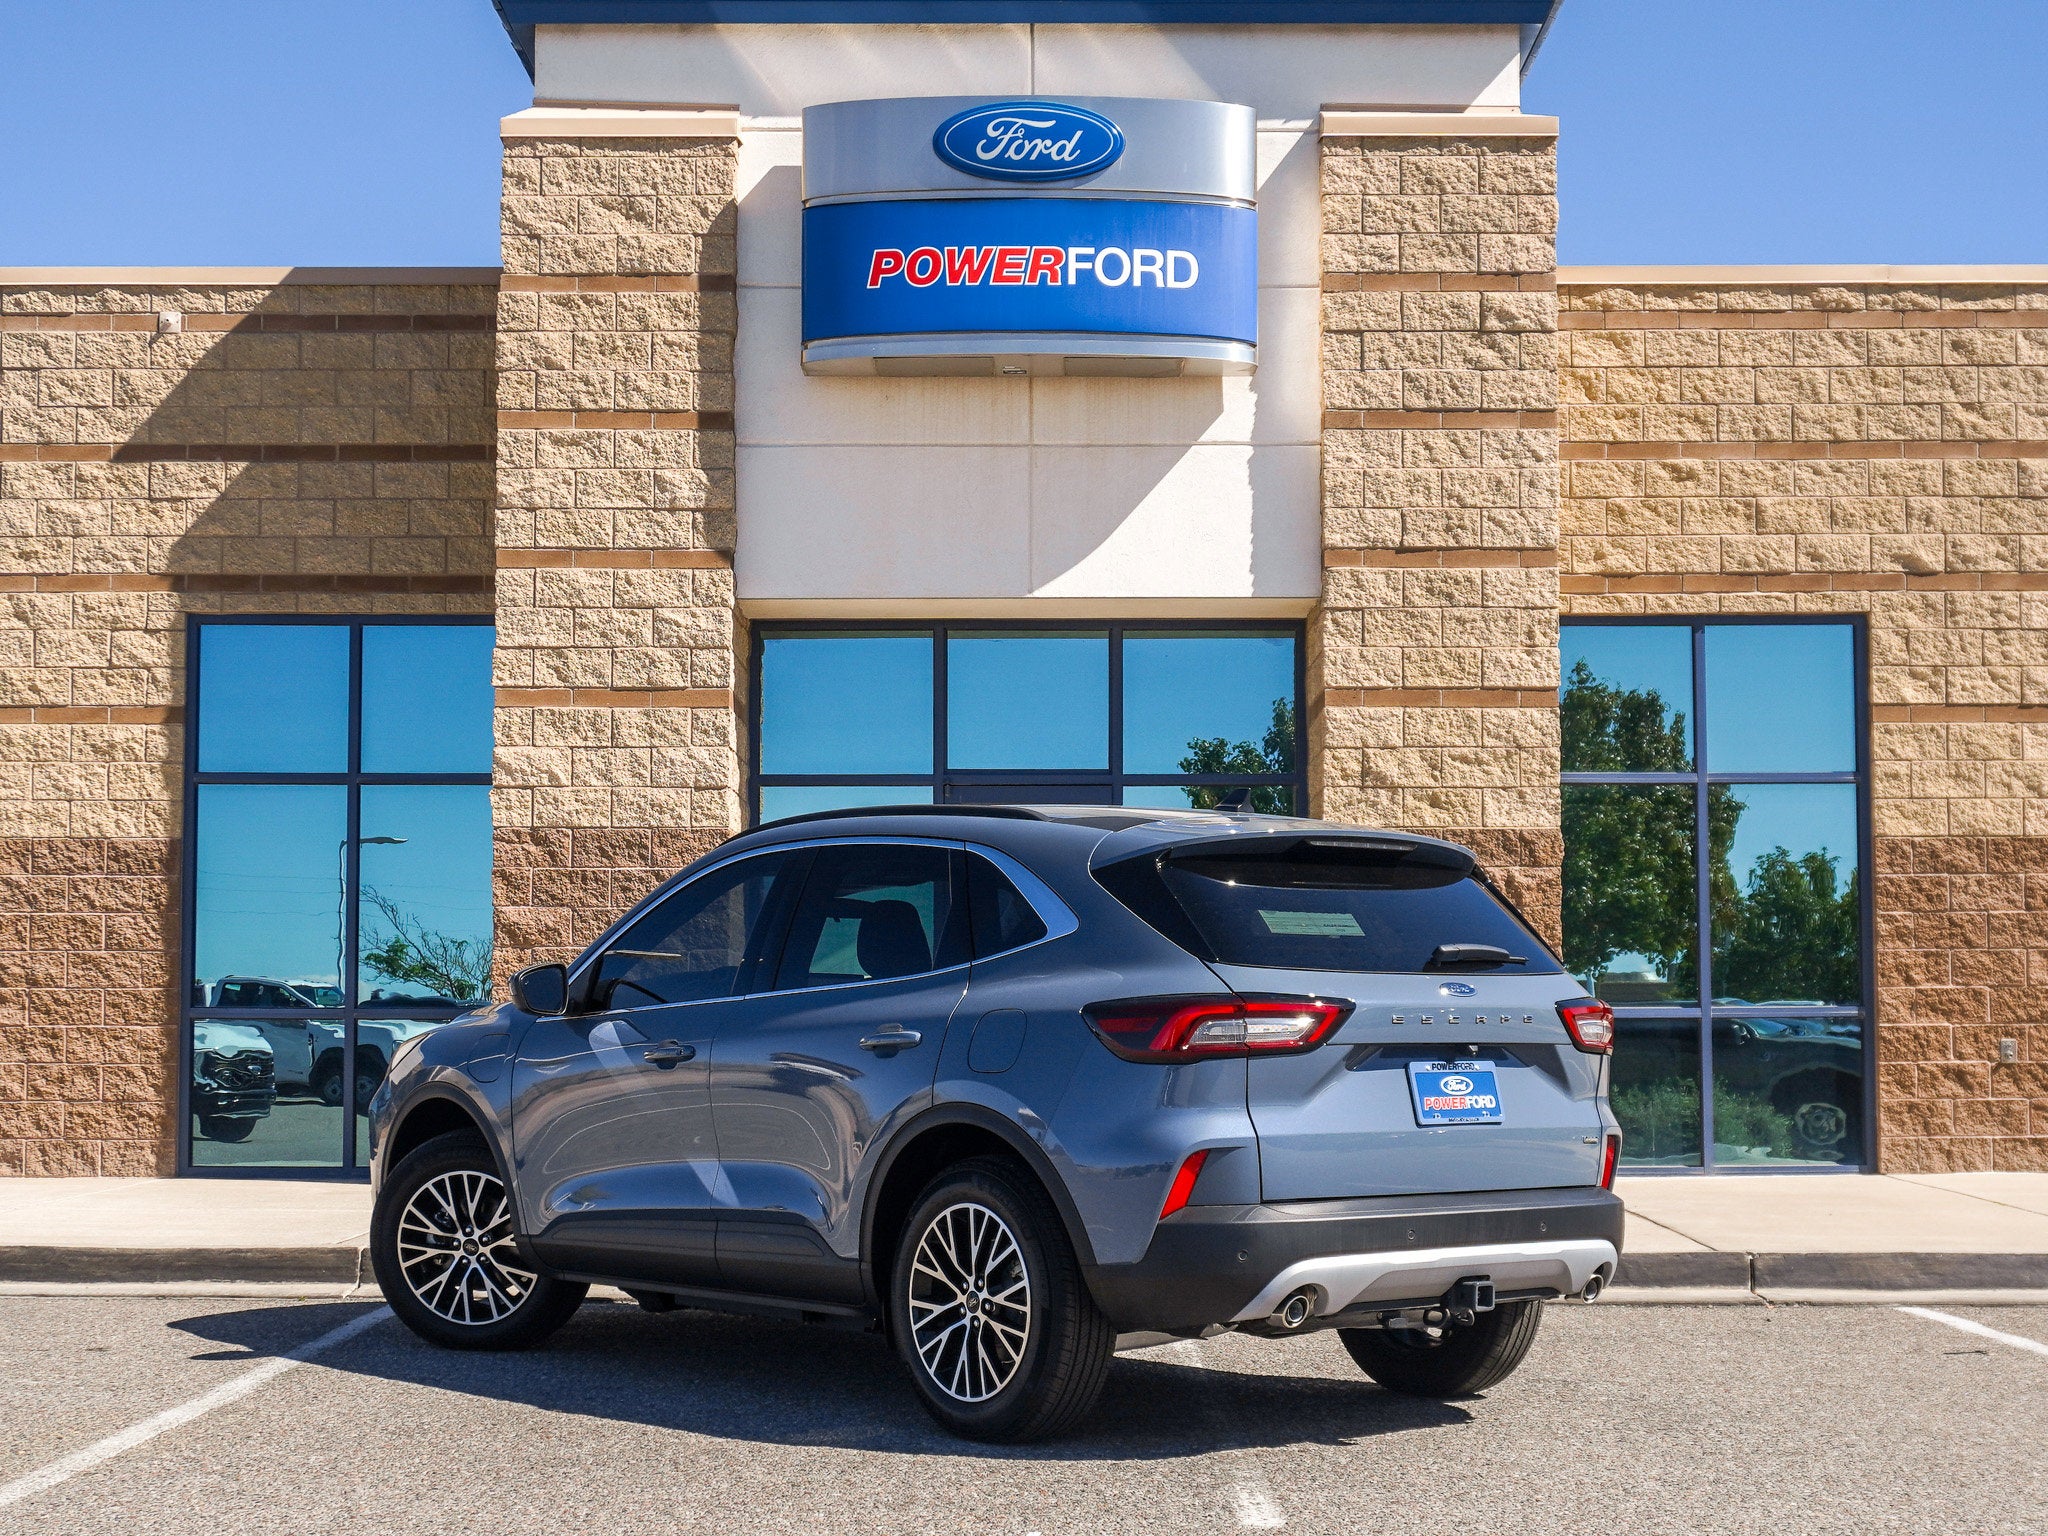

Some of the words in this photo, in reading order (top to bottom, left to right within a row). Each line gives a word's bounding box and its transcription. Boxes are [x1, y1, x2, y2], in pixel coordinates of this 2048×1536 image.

[976, 117, 1083, 162] Ford
[866, 245, 1200, 289] POWERFORD
[1391, 1014, 1534, 1025] ESCAPE
[1431, 1062, 1475, 1071] POWERFORD
[1424, 1095, 1497, 1111] POWERFORD
